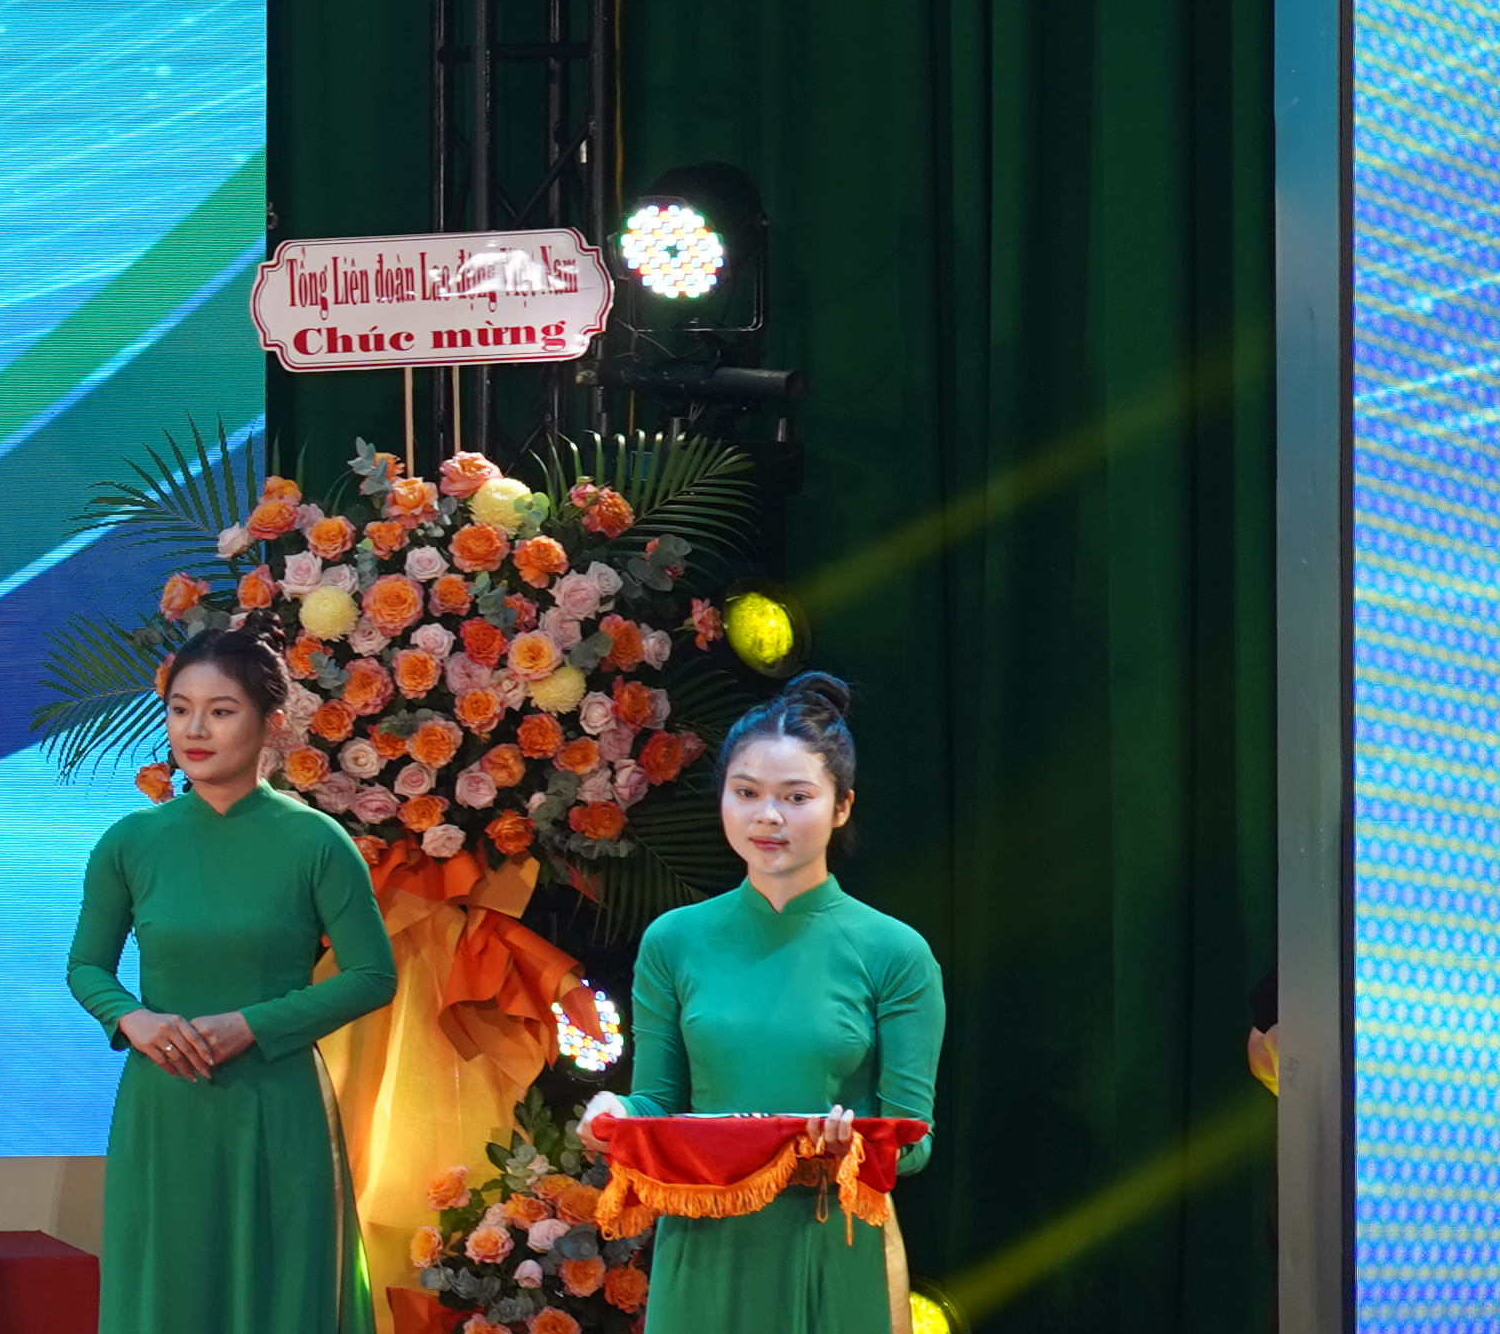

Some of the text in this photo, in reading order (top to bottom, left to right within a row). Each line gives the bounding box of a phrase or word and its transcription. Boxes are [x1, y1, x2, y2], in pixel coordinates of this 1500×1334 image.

[286, 246, 329, 320] Tổng
[331, 256, 371, 305] Liên
[374, 253, 416, 304] đoàn
[419, 252, 451, 301] Lao
[293, 320, 567, 356] Chúc mừng
